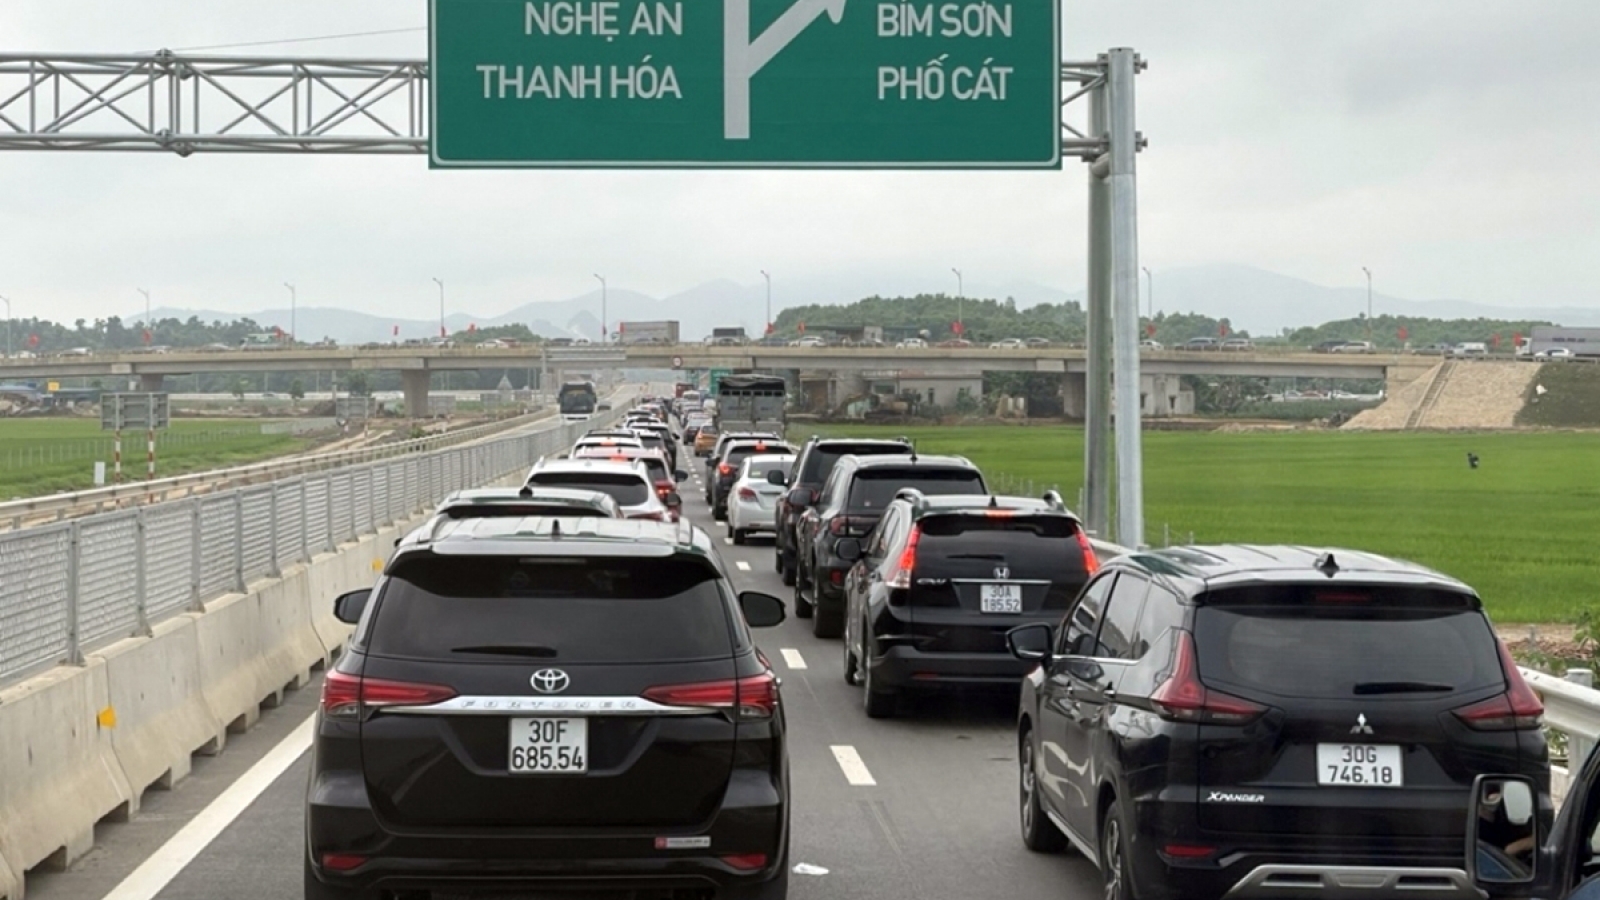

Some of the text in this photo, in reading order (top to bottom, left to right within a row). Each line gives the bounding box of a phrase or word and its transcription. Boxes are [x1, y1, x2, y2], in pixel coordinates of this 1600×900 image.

[628, 1, 683, 36] AN
[939, 0, 1012, 37] SƠN
[475, 54, 683, 99] THANH HÓA
[878, 53, 1014, 100] PHỐ CÁT
[528, 720, 568, 743] 30F
[511, 745, 584, 770] 685.54
[1341, 745, 1377, 763] 30G
[1327, 765, 1393, 784] 746.18
